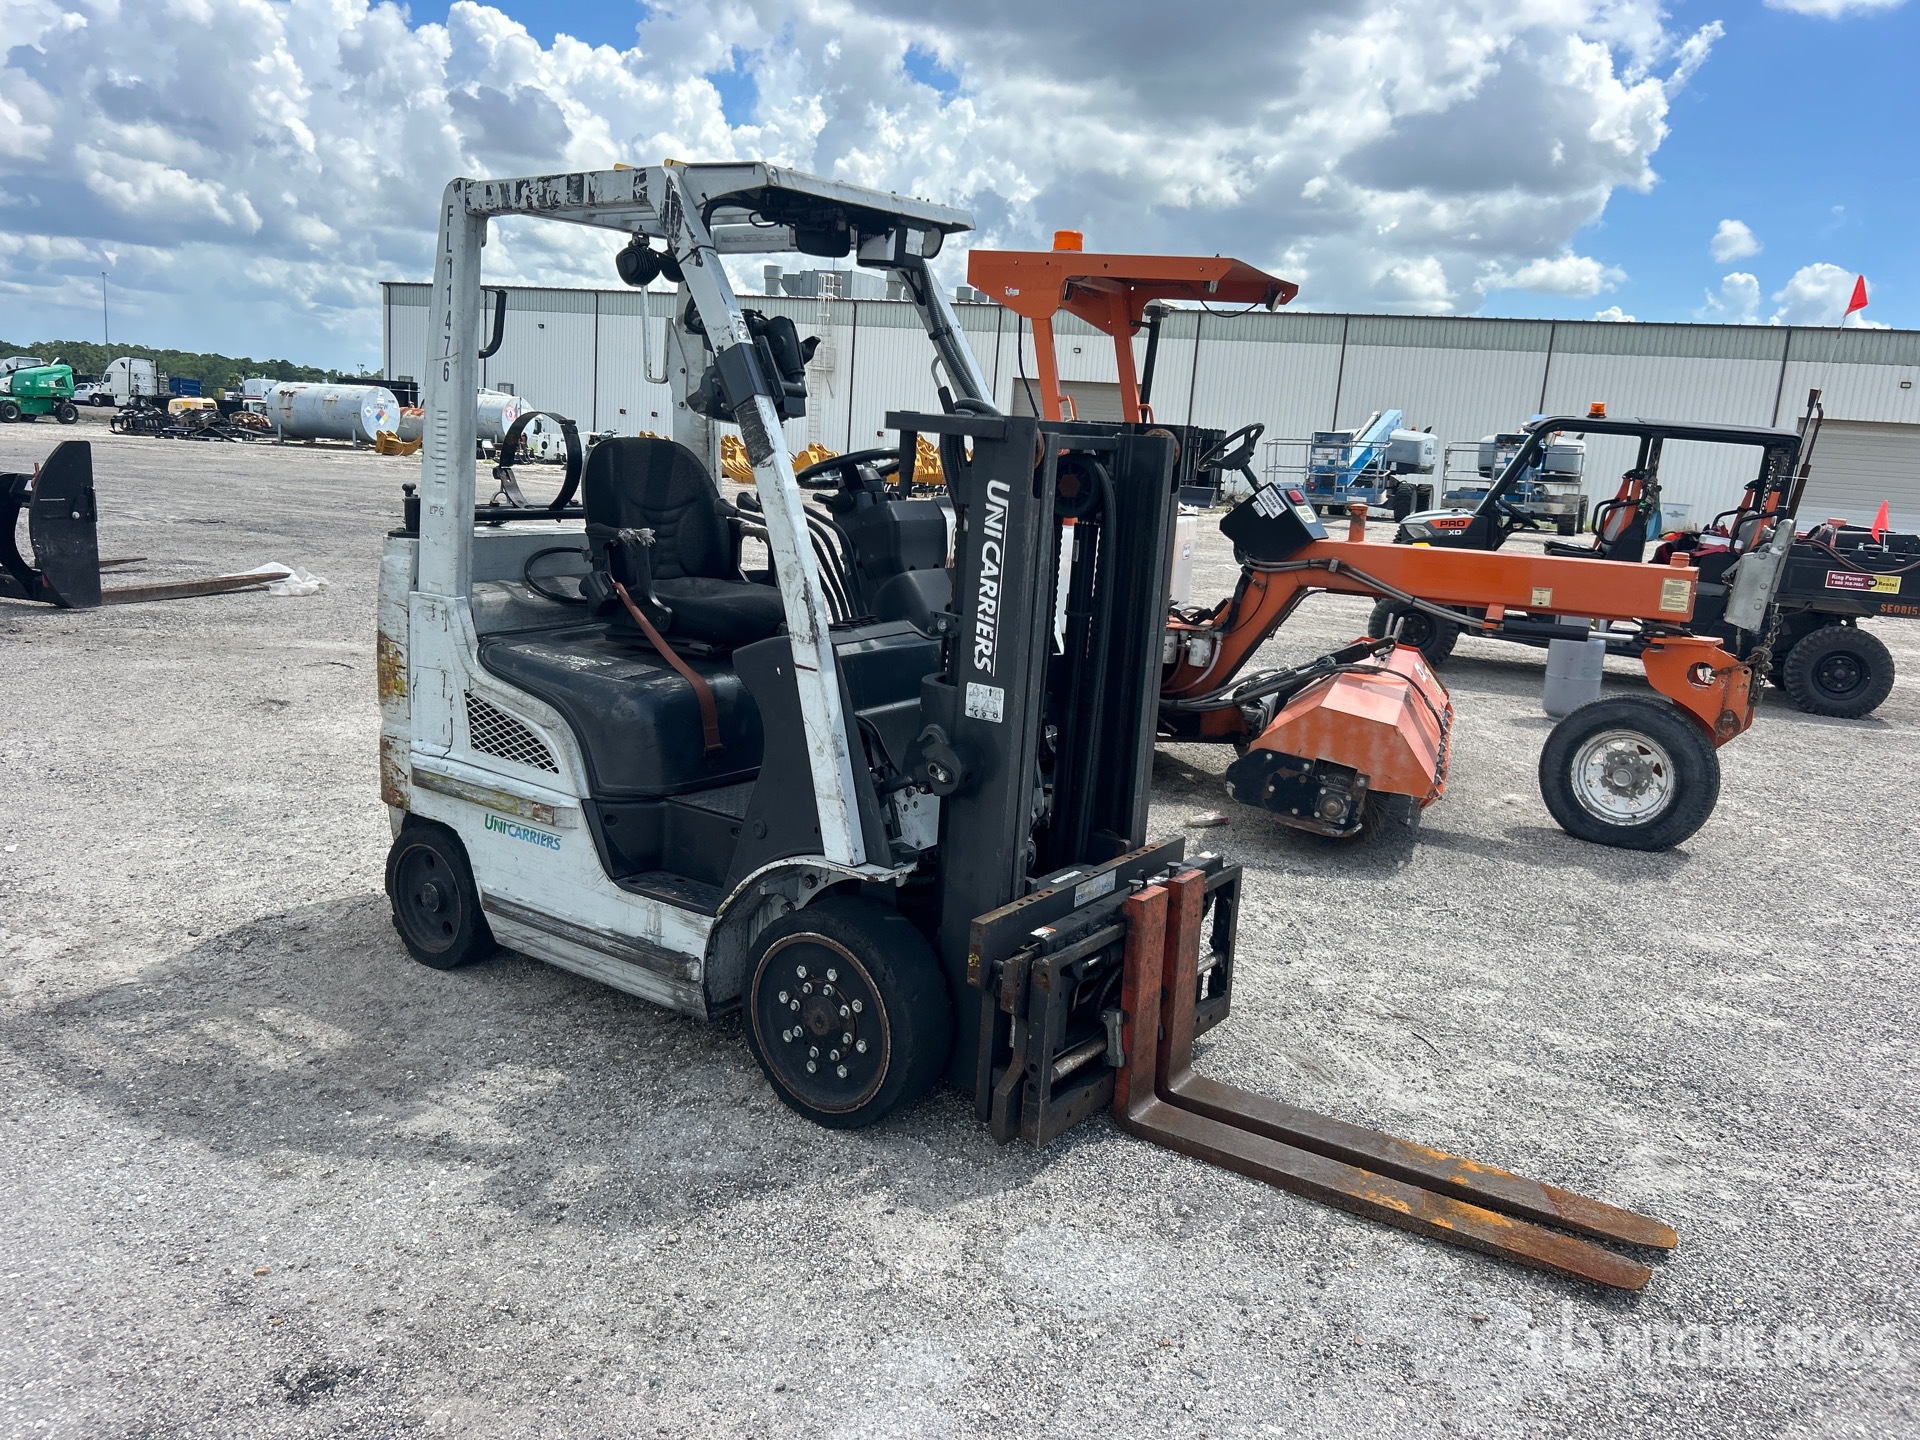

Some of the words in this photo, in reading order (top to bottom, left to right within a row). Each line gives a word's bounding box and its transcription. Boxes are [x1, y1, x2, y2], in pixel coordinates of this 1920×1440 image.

[442, 205, 454, 382] FL11476
[973, 479, 1011, 677] UNICARRIERS
[484, 813, 563, 851] UNICARRIERS
